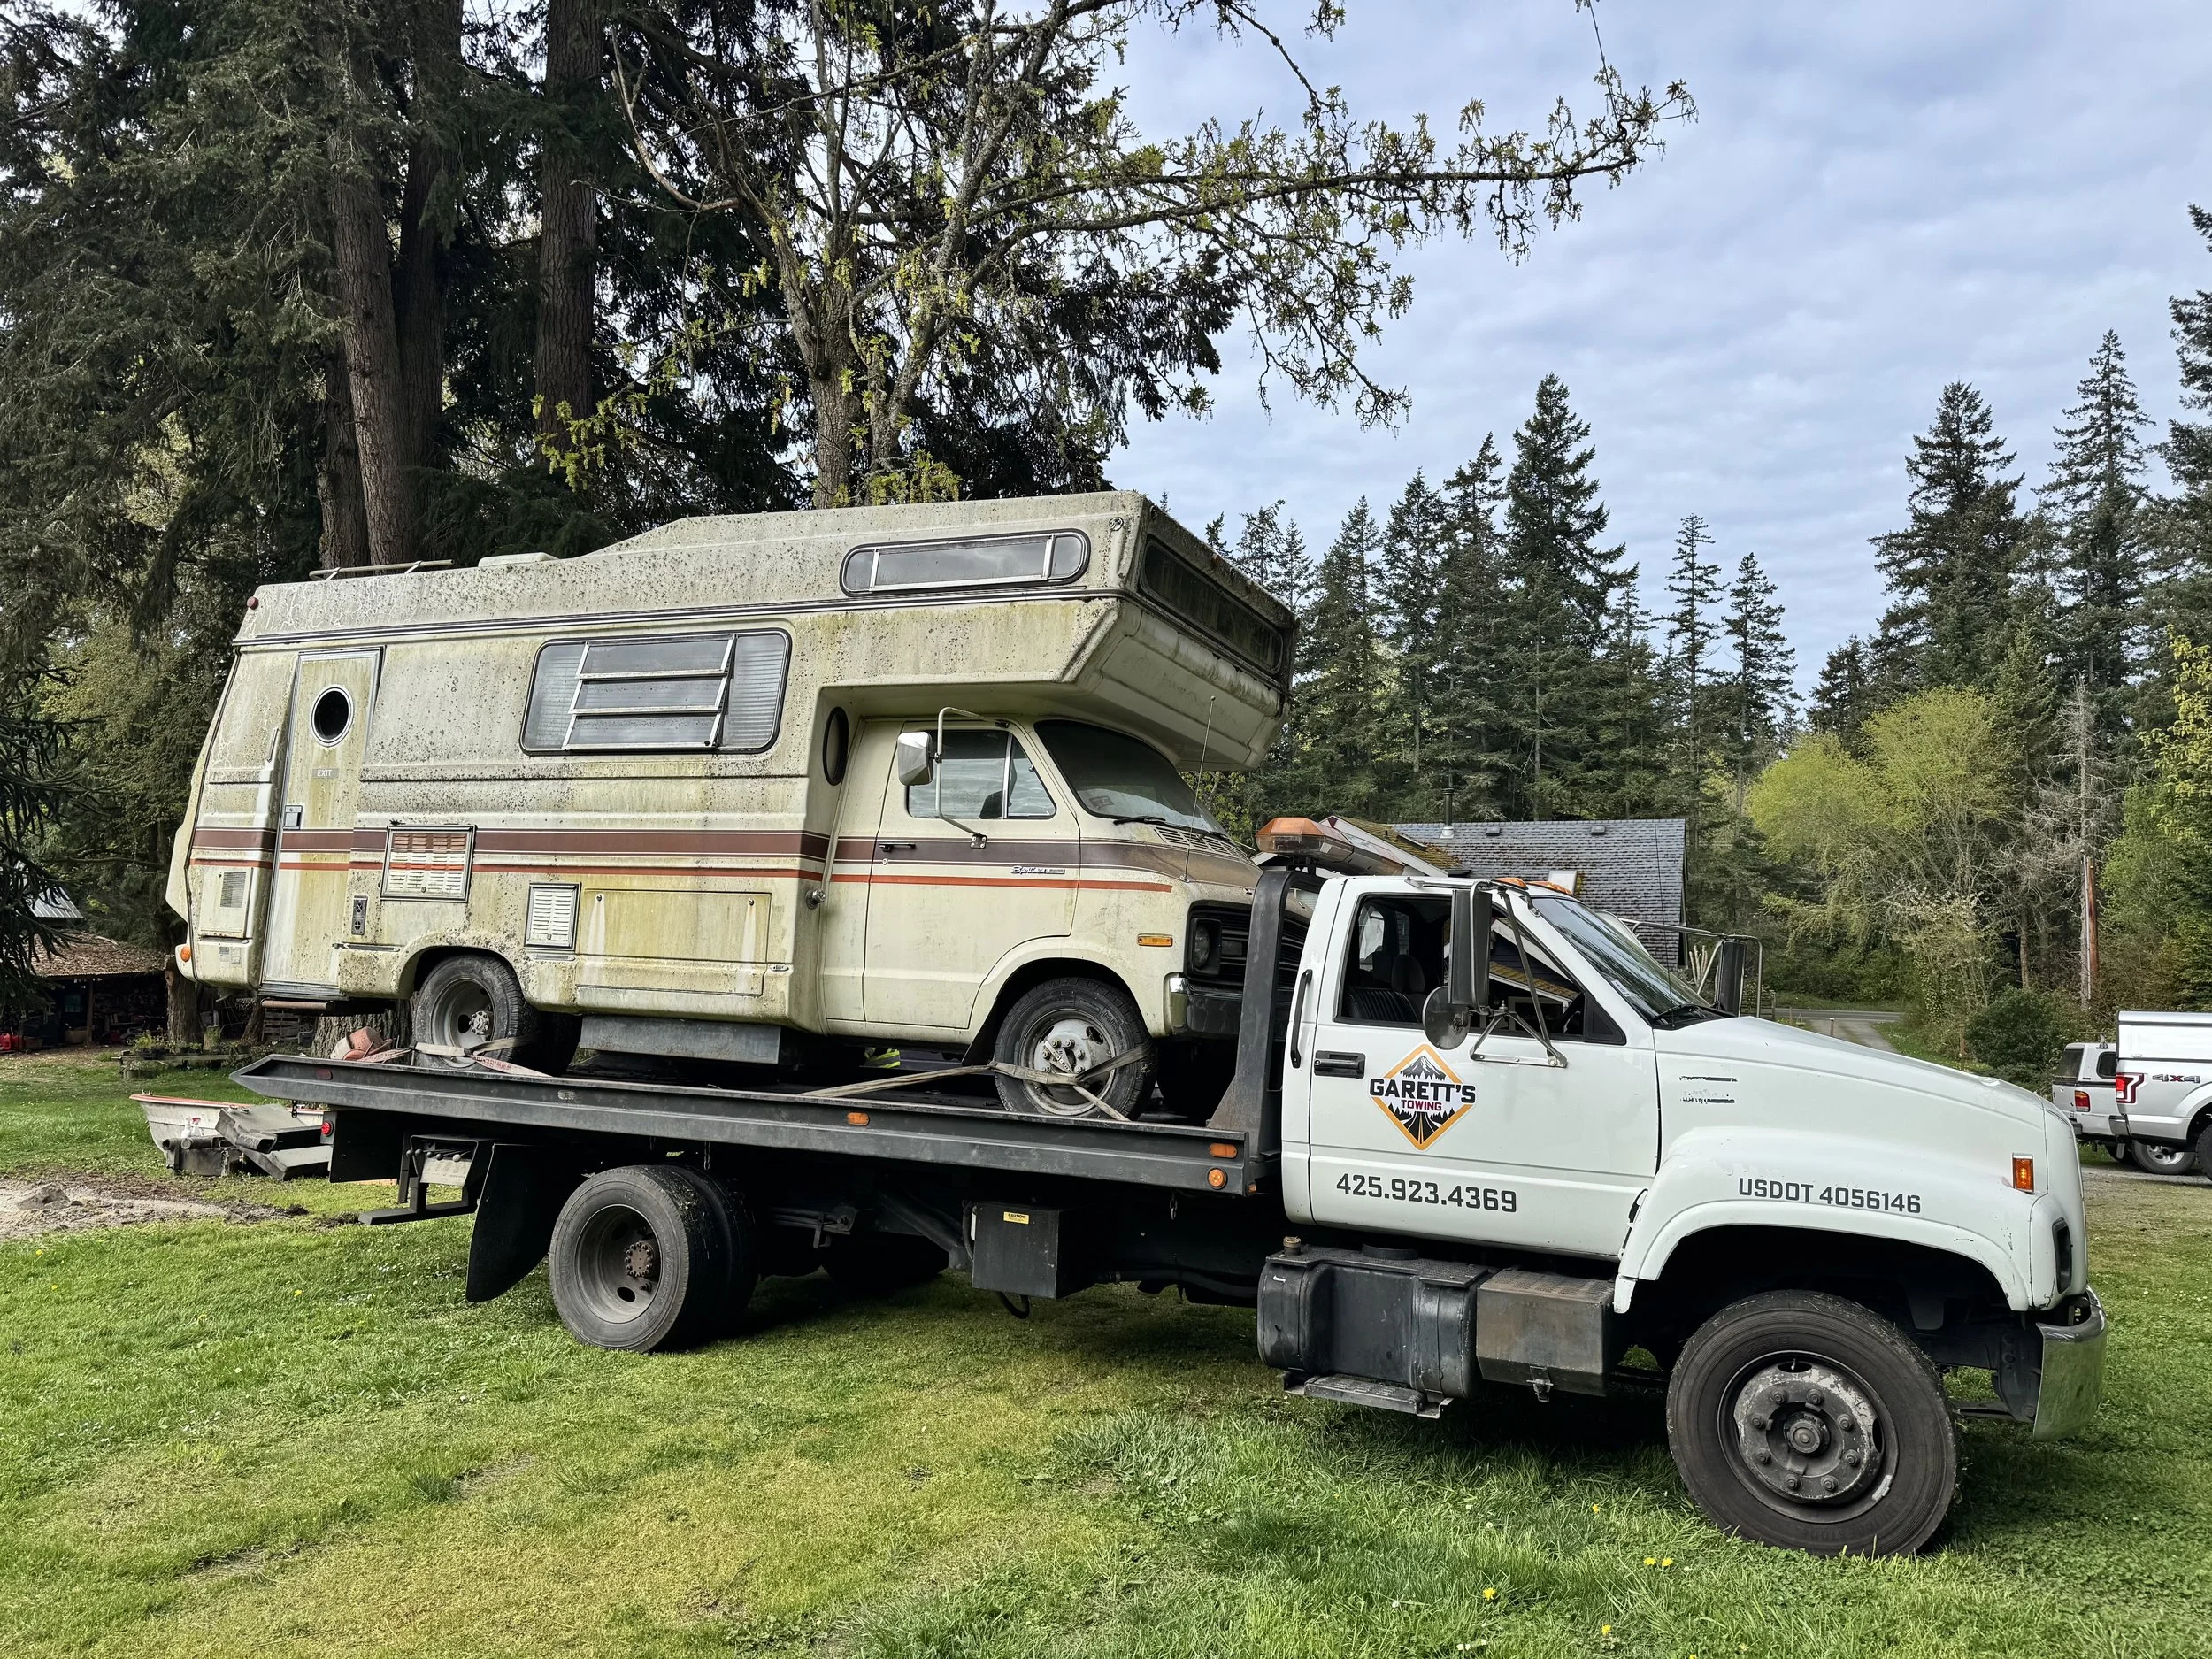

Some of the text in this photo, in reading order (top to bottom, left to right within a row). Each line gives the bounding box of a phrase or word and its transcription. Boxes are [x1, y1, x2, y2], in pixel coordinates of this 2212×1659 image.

[1369, 1078, 1476, 1104] GARETT'S
[1401, 1099, 1442, 1112] TOWING
[1336, 1173, 1517, 1213] 425.923.4369
[1738, 1177, 1921, 1214] USDOT 4056146
